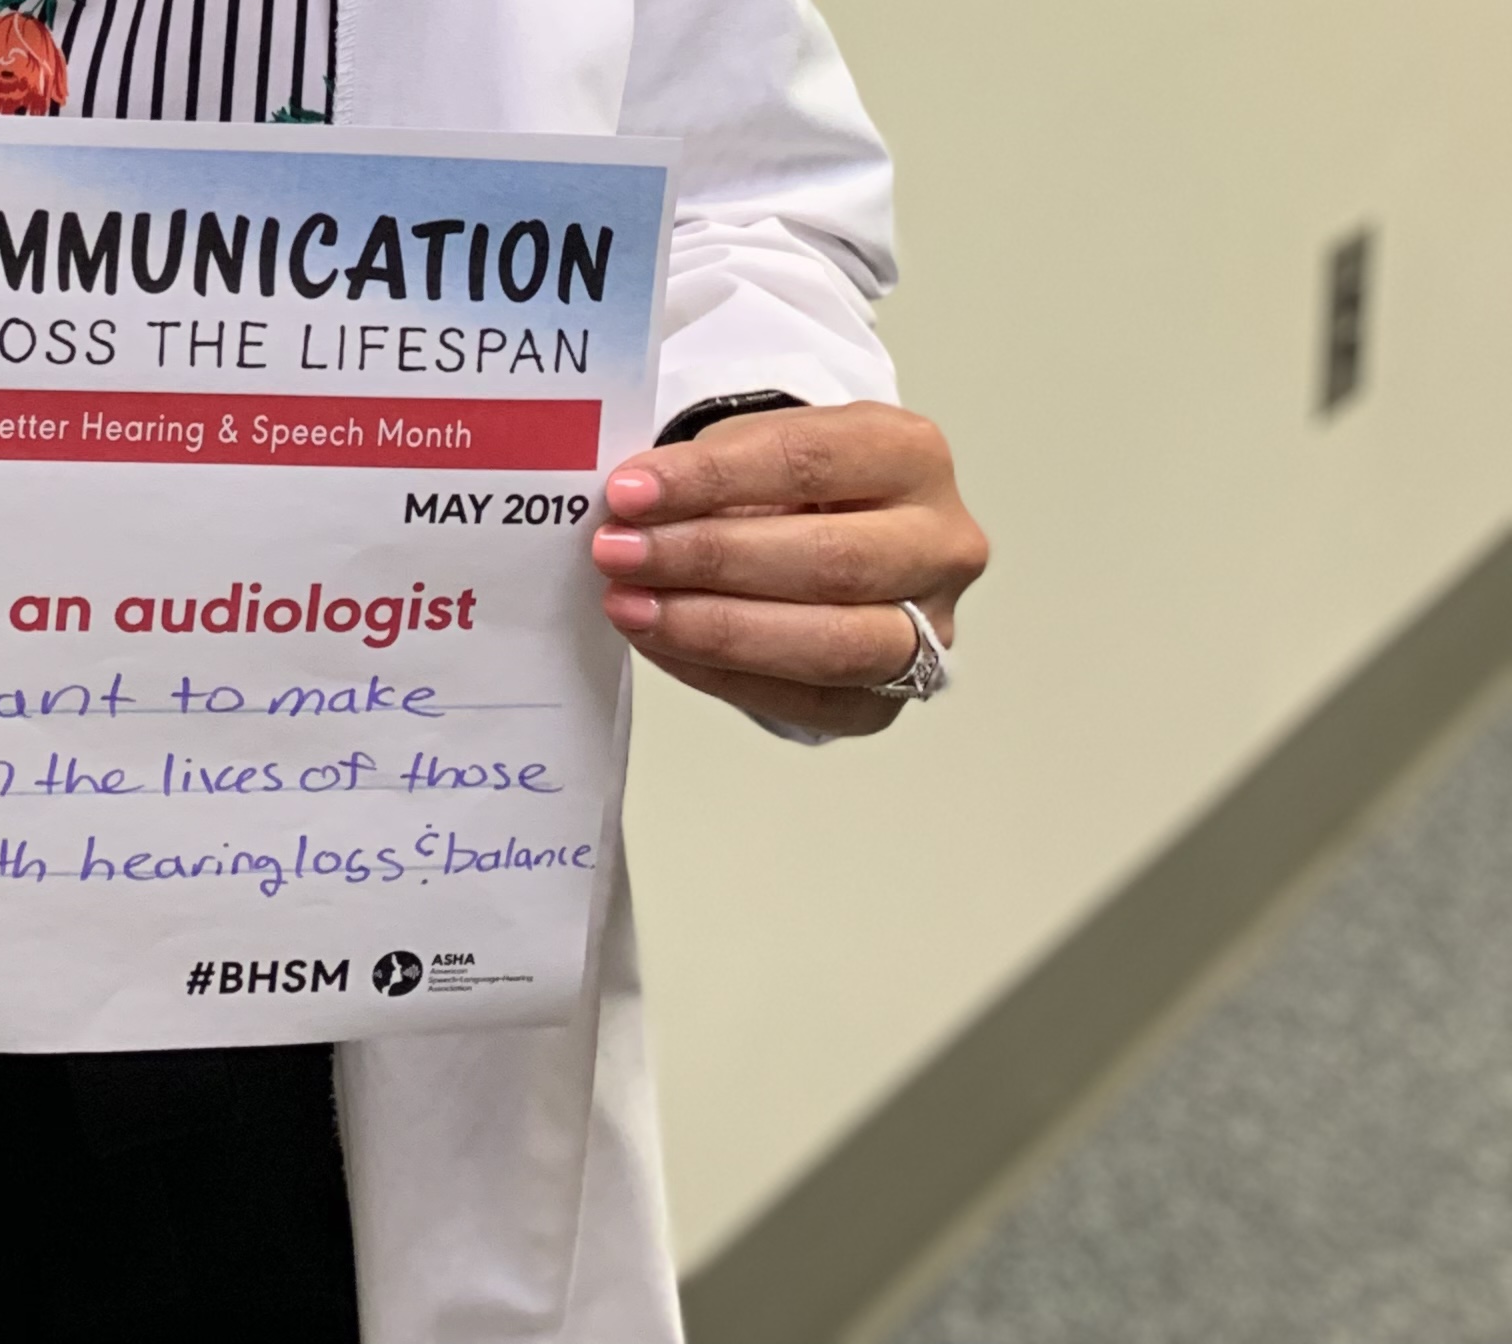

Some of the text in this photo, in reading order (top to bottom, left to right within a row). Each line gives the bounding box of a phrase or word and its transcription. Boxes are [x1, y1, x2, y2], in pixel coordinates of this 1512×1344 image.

[146, 319, 269, 370] THE
[300, 323, 590, 375] LIFESPAN
[82, 411, 205, 453] Hearing
[217, 414, 239, 444] &
[252, 414, 363, 454] Speech
[376, 418, 472, 449] Month
[404, 493, 590, 526] MAY 2019
[8, 595, 92, 632] an
[113, 582, 478, 649] audiologist
[172, 676, 245, 713] to
[267, 675, 446, 718] make
[35, 751, 143, 795] the
[163, 752, 284, 796] lives
[299, 751, 378, 792] of
[399, 752, 563, 793] those
[78, 835, 288, 898] hearing
[294, 833, 405, 884] loss
[185, 958, 351, 996] #BHSM
[431, 953, 476, 967] ASHA
